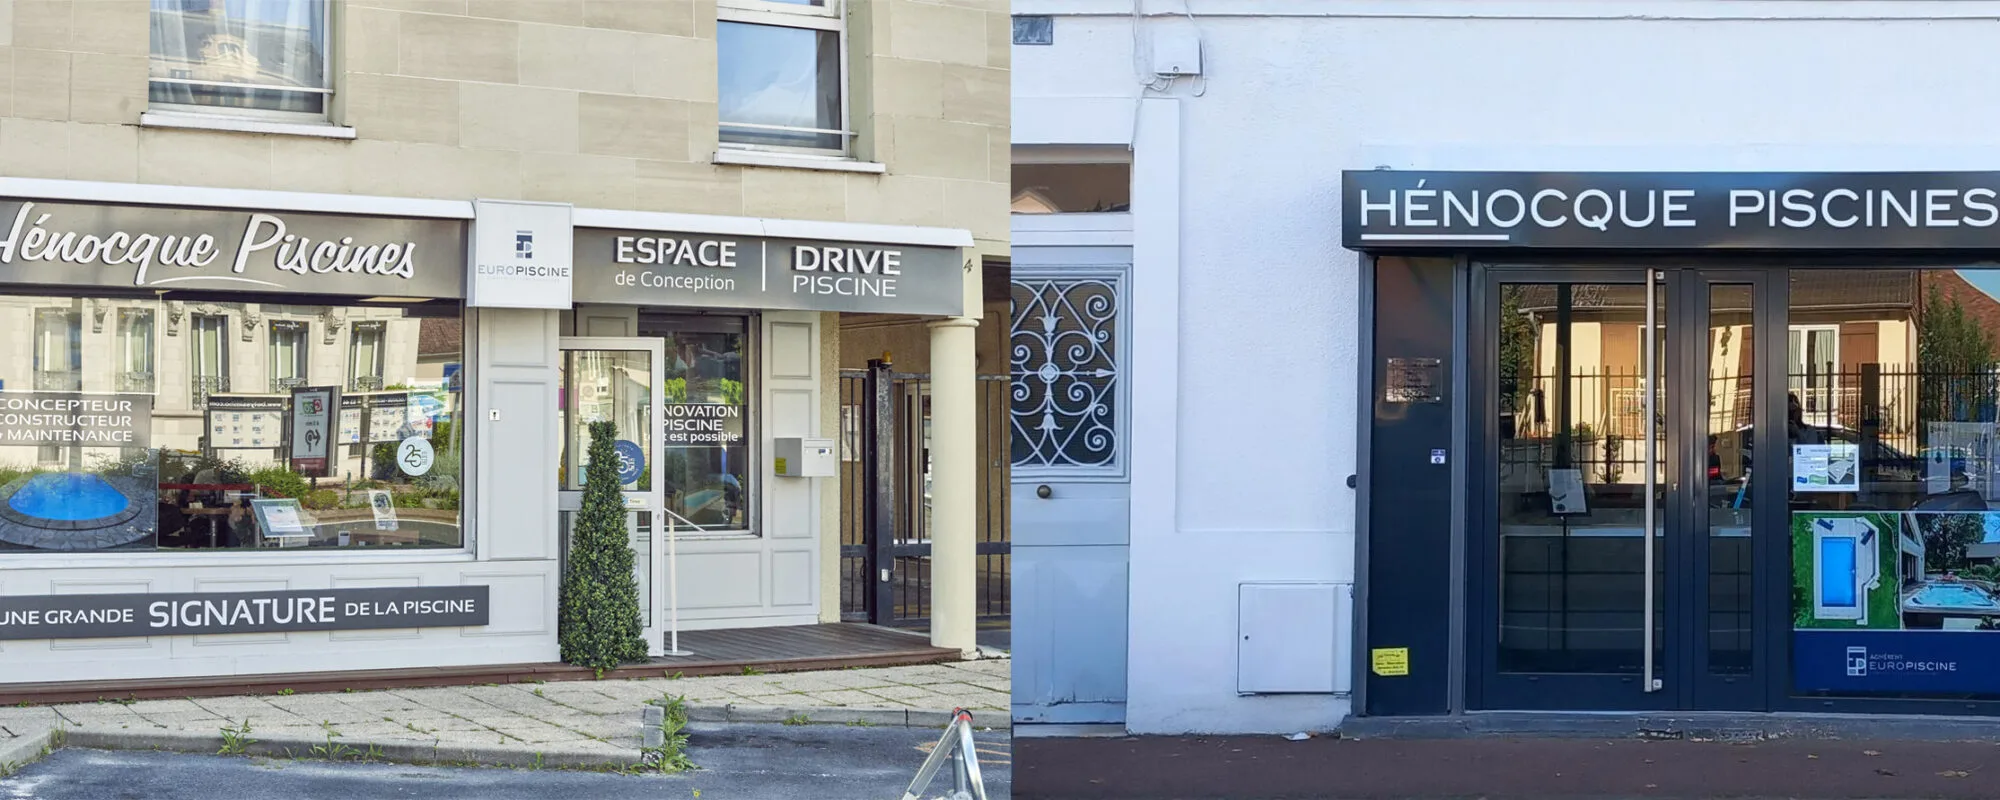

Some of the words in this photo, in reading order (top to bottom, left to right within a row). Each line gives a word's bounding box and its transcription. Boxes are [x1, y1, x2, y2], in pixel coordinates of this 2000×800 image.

[1360, 179, 1697, 231] HÉNOCQUE
[1729, 188, 1999, 228] PISCINES
[233, 213, 416, 279] Piscines
[615, 236, 737, 268] ESPACE
[478, 264, 569, 278] EUROPISCINE
[793, 245, 901, 275] DRIVE
[615, 270, 636, 286] de
[640, 271, 735, 293] Conception
[793, 275, 897, 297] PISCINE
[643, 405, 738, 418] RNOVATION
[7, 428, 133, 442] MAINTENANCE
[669, 432, 687, 441] est
[690, 431, 739, 443] possible
[404, 444, 422, 468] 25
[44, 608, 134, 624] GRANDE
[149, 596, 336, 628] SIGNATURE
[345, 602, 370, 616] DE
[375, 601, 399, 616] LA
[403, 599, 475, 615] PISCINE
[1869, 661, 1957, 671] EUROPISCINE
